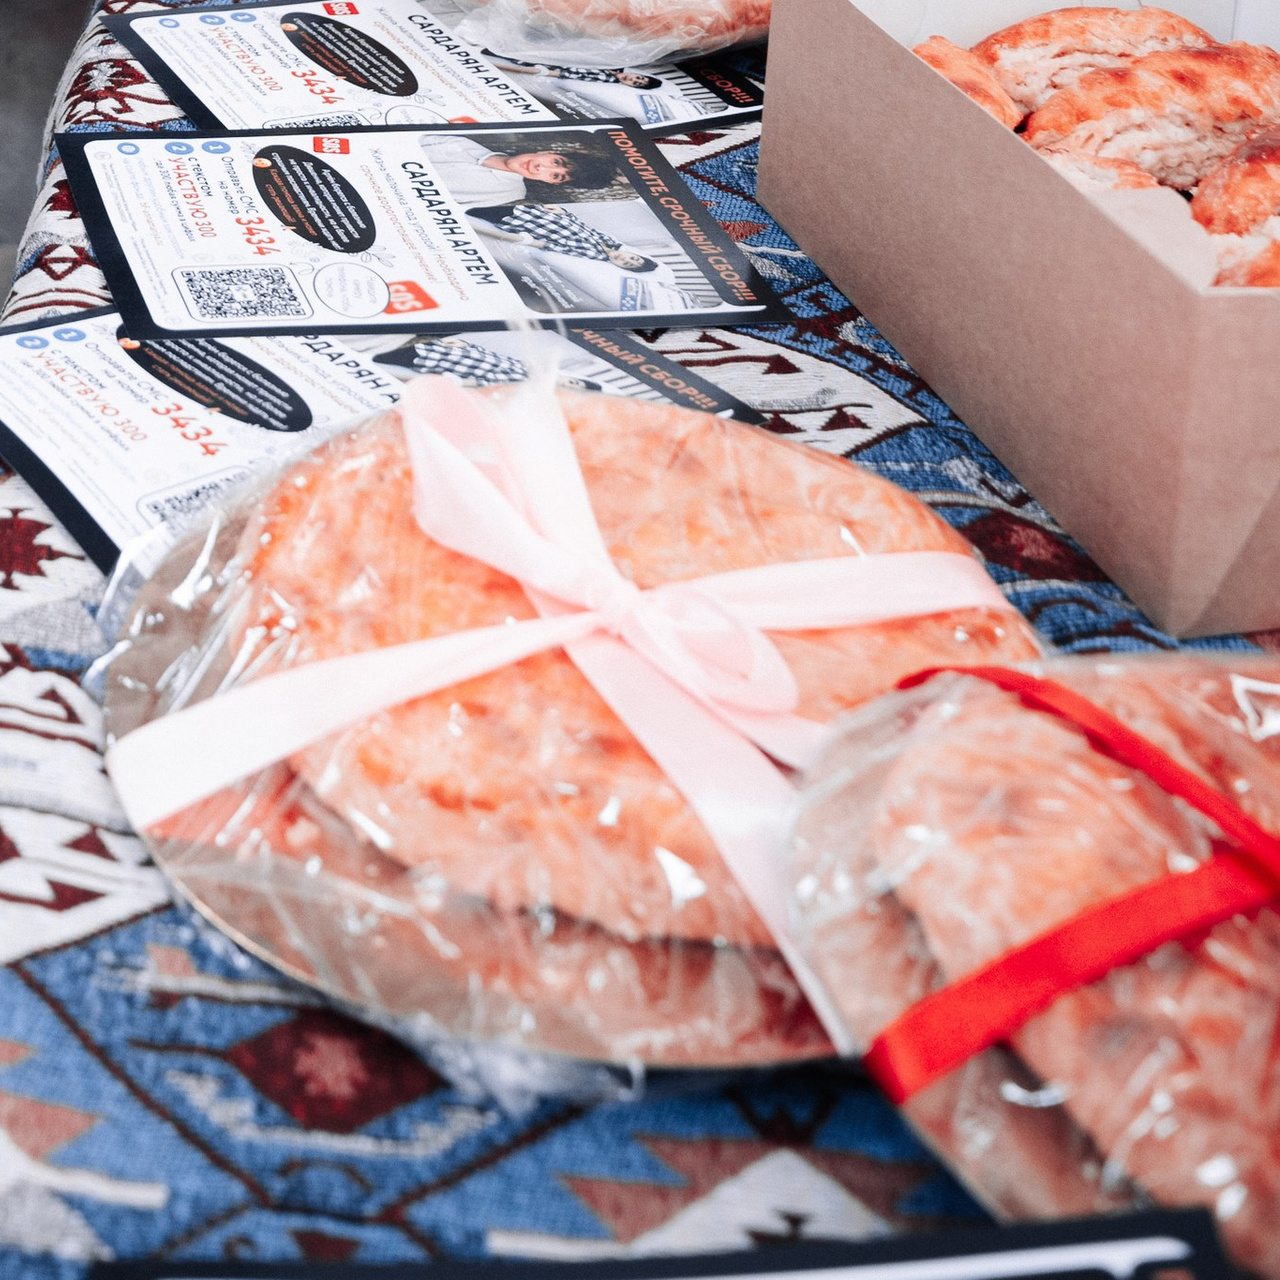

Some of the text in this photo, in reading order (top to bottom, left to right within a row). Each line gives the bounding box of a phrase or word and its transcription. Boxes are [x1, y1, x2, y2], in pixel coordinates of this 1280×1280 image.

[288, 68, 348, 105] 3434
[403, 13, 491, 73] САРДАРЯН
[475, 74, 542, 114] АРТЕМ
[321, 137, 341, 153] SOS
[166, 156, 218, 238] УЧАСТВУЮ 300
[237, 195, 260, 214] СМС
[398, 161, 499, 284] САРДАРЯН АРТЕМ
[605, 130, 759, 301] ПОМОГИТЕ, СРОЧНЫЙ СБОР!!!
[233, 216, 283, 255] 3434
[292, 331, 393, 390] РДАРЯН
[580, 330, 719, 410] ЧНЫЙ СБОР!!!
